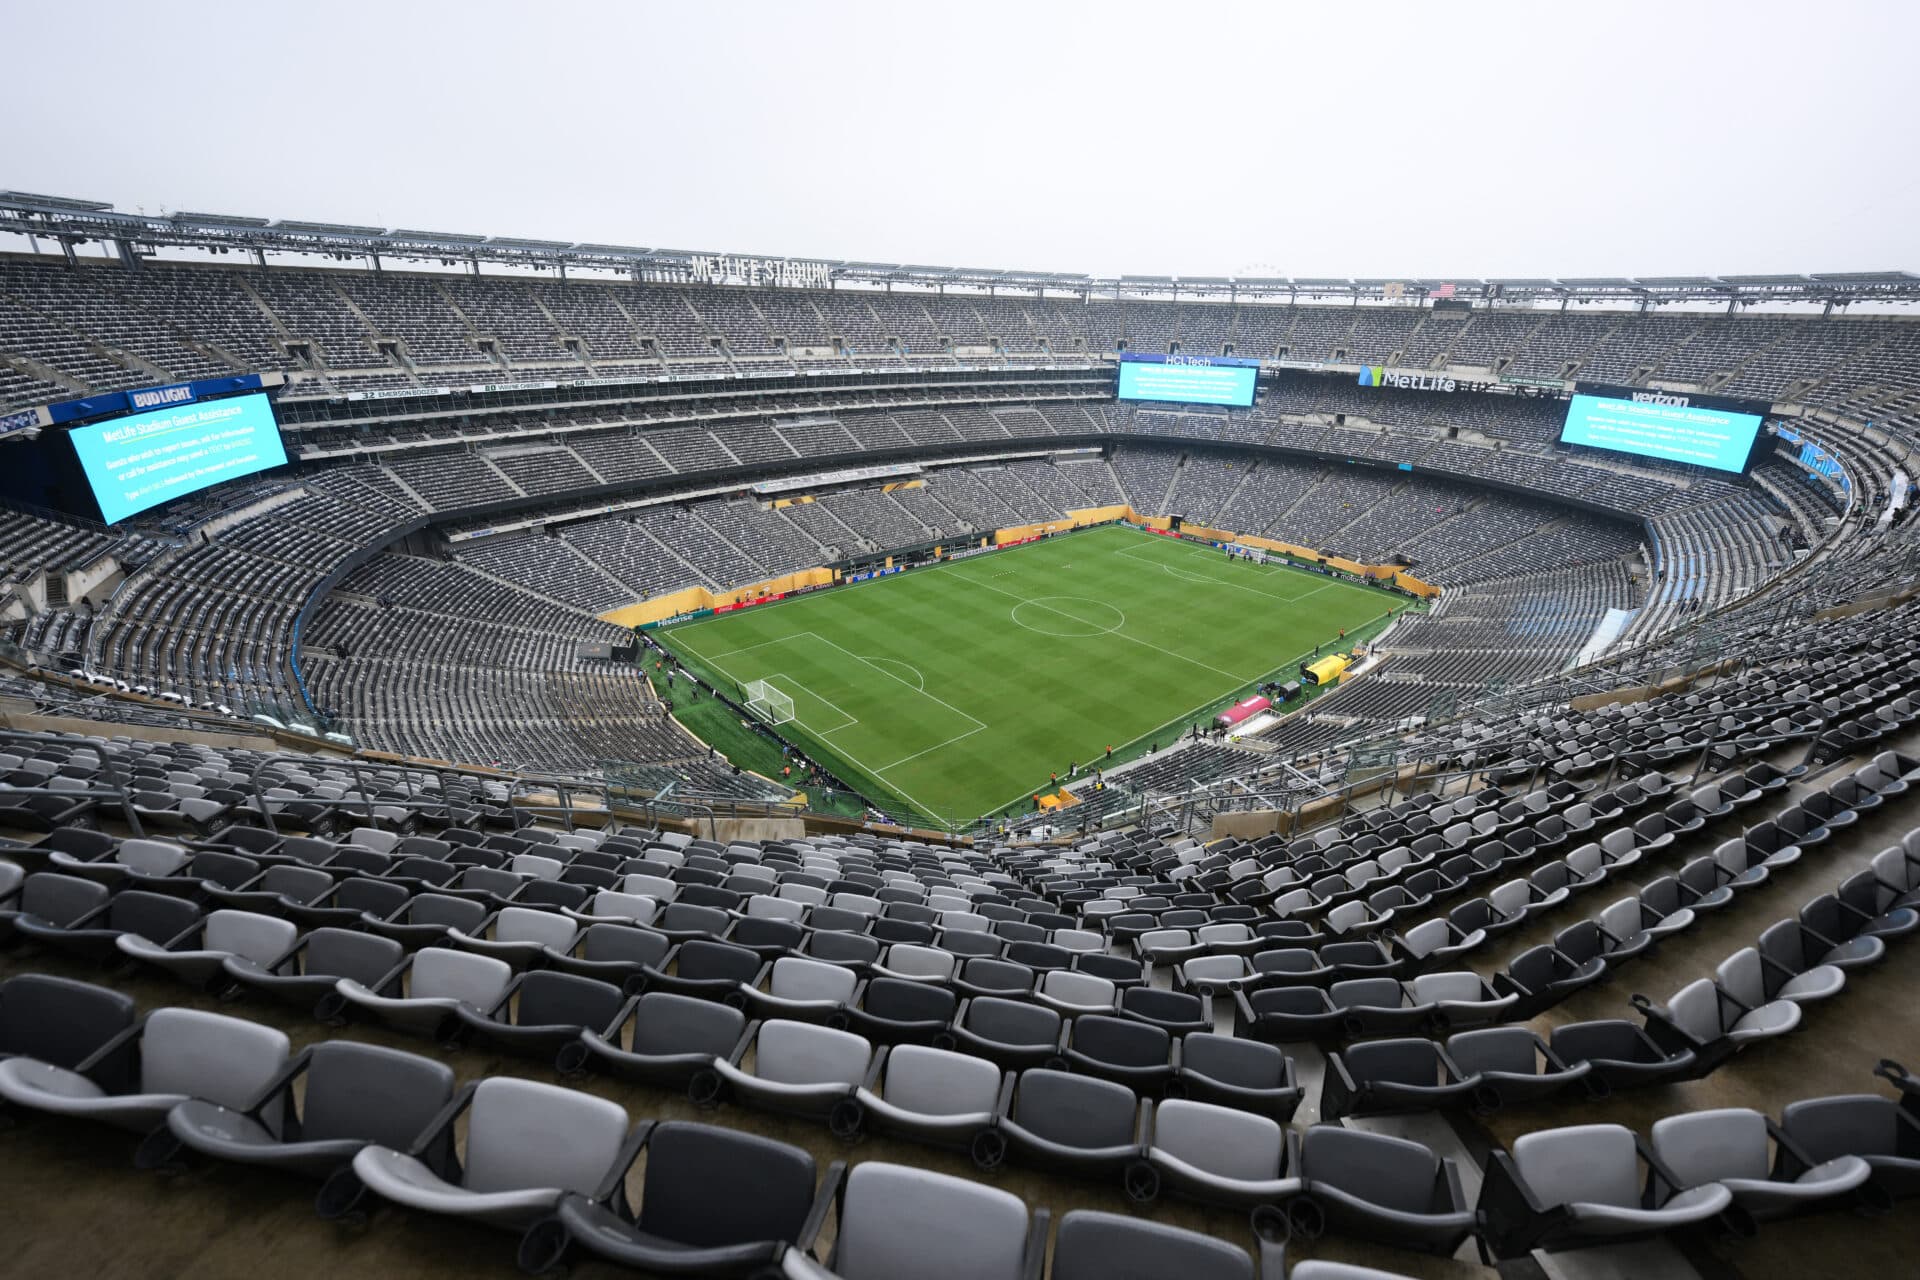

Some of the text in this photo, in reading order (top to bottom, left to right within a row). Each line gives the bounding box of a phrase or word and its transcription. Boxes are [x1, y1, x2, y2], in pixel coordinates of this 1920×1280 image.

[692, 255, 829, 282] METLIFE STADIUM
[1165, 355, 1212, 367] HCLTech
[1382, 371, 1456, 393] MetLife
[133, 386, 193, 408] BUD LIGHT
[361, 388, 438, 400] 32 EMERSON BOOZER
[1632, 391, 1690, 408] verizon
[102, 405, 243, 443] MetLife Stadium Guest Assistance
[1685, 411, 1730, 425] Assistance
[1340, 573, 1369, 586] motorola
[657, 614, 694, 628] Hisense
